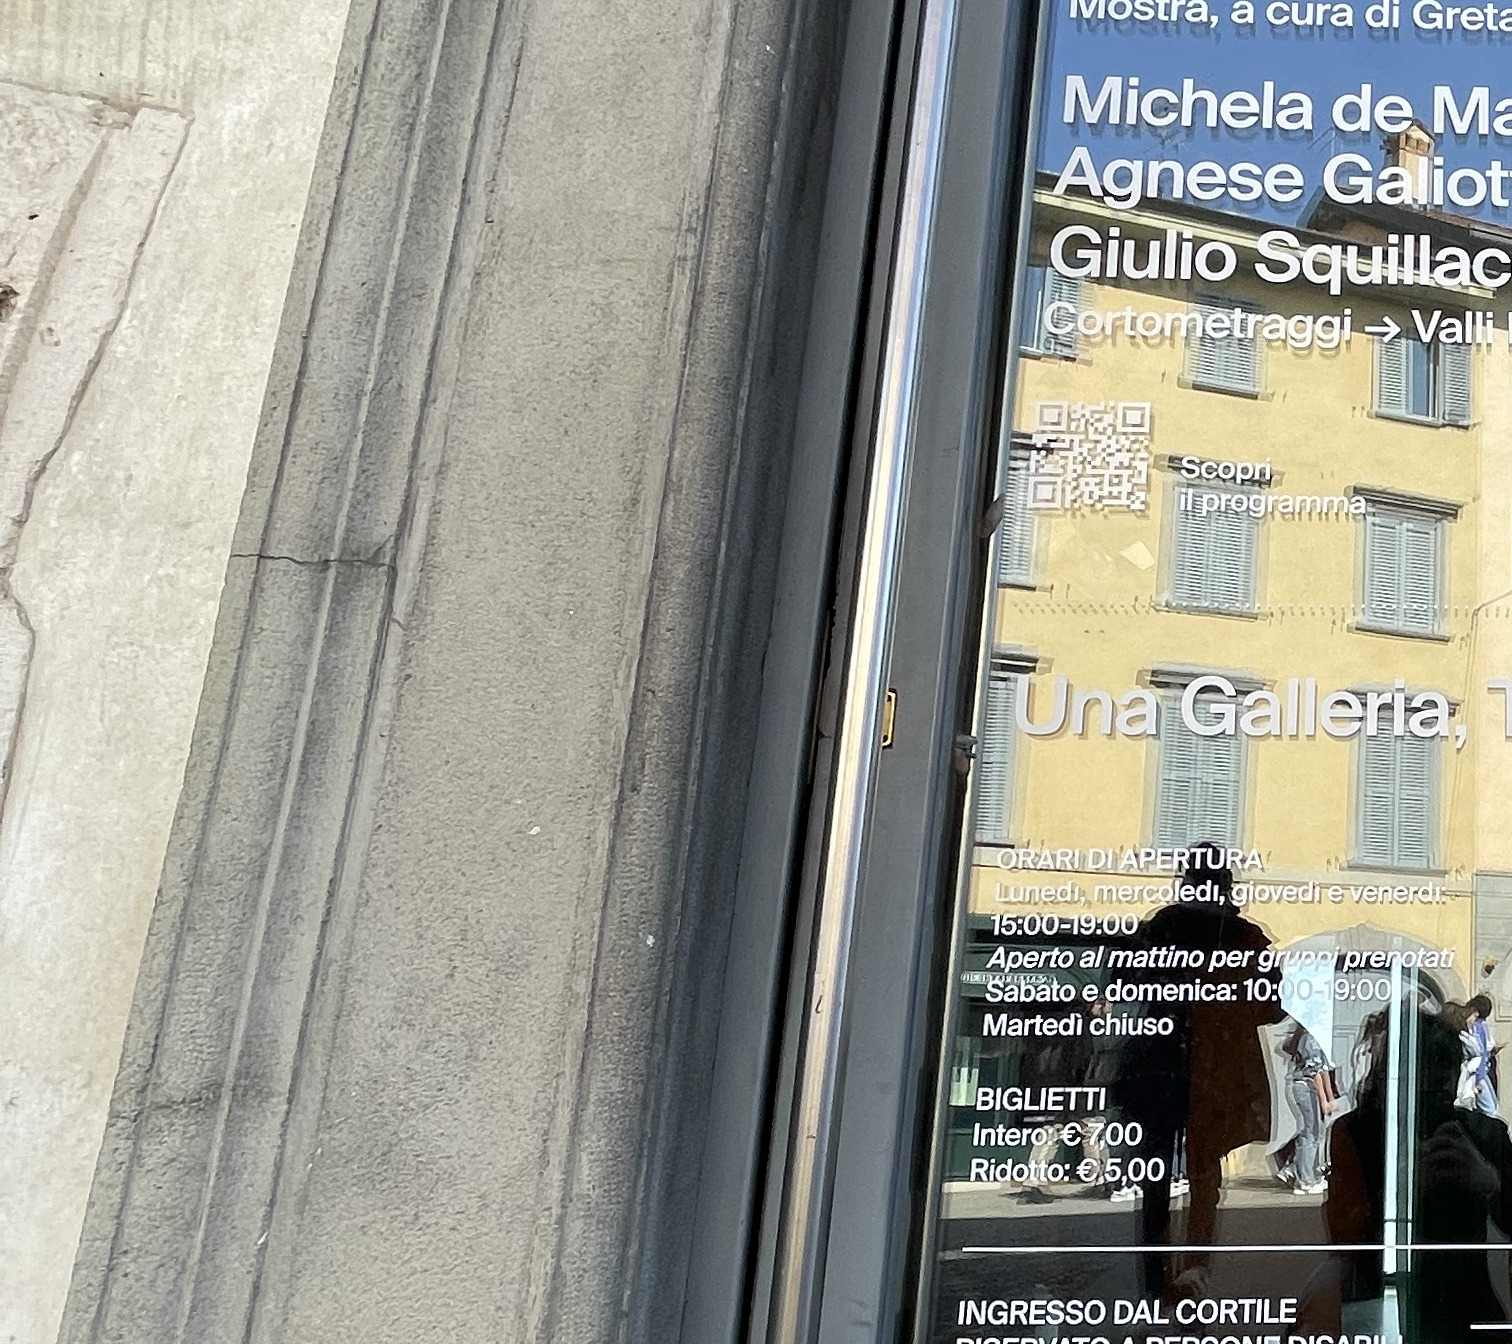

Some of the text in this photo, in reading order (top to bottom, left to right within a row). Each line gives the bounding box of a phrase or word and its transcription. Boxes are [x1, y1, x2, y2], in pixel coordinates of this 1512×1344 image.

[1231, 1, 1254, 24] a
[1266, 3, 1353, 27] cura
[1365, 0, 1400, 29] di
[1063, 74, 1313, 131] Michela
[1332, 83, 1414, 132] de
[1052, 145, 1304, 210] Agnese
[1050, 225, 1236, 282] Giulio
[1043, 301, 1352, 349] Cortometraggi
[1412, 309, 1494, 344] Valli
[1180, 457, 1271, 481] Scopri
[1180, 490, 1367, 516] il programma
[1015, 676, 1161, 736] Una
[1181, 675, 1469, 751] Galleria,
[997, 848, 1263, 869] ORARI DI APERTURA
[1232, 881, 1320, 906] giovedì
[1328, 885, 1342, 901] e
[990, 913, 1138, 936] 15:00-19:00
[986, 945, 1454, 971] Aperto al mattino per gruppi prenotati
[985, 981, 1075, 1002] Sabato
[1082, 985, 1098, 1001] e
[1105, 979, 1237, 1001] domenica:
[982, 1013, 1173, 1036] Martedì chiuso
[976, 1087, 1106, 1112] BIGLIETTI
[972, 1122, 1143, 1150] Intero: € 7,00
[969, 1157, 1165, 1186] Ridotto: € 5,00
[957, 1298, 1298, 1325] INGRESSO DAL CORTILE
